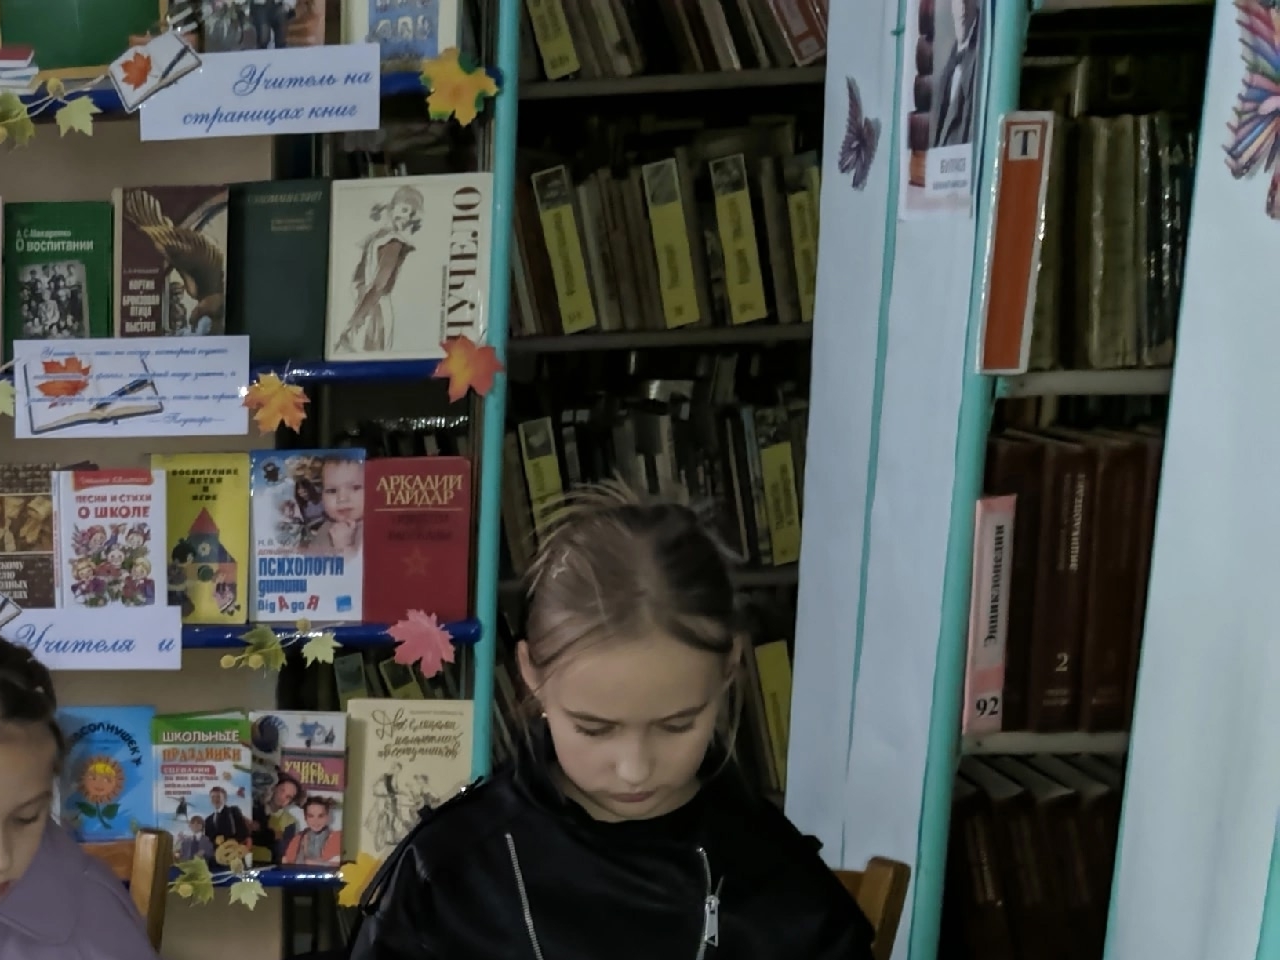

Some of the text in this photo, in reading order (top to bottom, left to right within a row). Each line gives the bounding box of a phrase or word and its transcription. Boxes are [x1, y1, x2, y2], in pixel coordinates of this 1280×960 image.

[232, 63, 373, 96] Учитель на
[183, 103, 358, 132] страницах книг
[16, 239, 94, 252] О воспитании
[446, 186, 482, 341] ЧУЧЕЛО
[75, 494, 151, 504] ПЕСНИ И СТИХИ
[78, 506, 150, 519] О ШКОЛЕ
[258, 557, 345, 576] ПСИХОЛОГІЯ
[277, 596, 290, 612] А
[307, 595, 320, 611] Я
[16, 623, 175, 654] Учителя и
[1055, 652, 1069, 672] 2
[975, 696, 999, 717] 92
[162, 730, 239, 743] ШКОЛЬНЫЕ
[162, 747, 242, 762] ПРАЗДНИКИ
[284, 760, 324, 773] УЧИСЬ
[300, 768, 339, 785] ИГРАЯ
